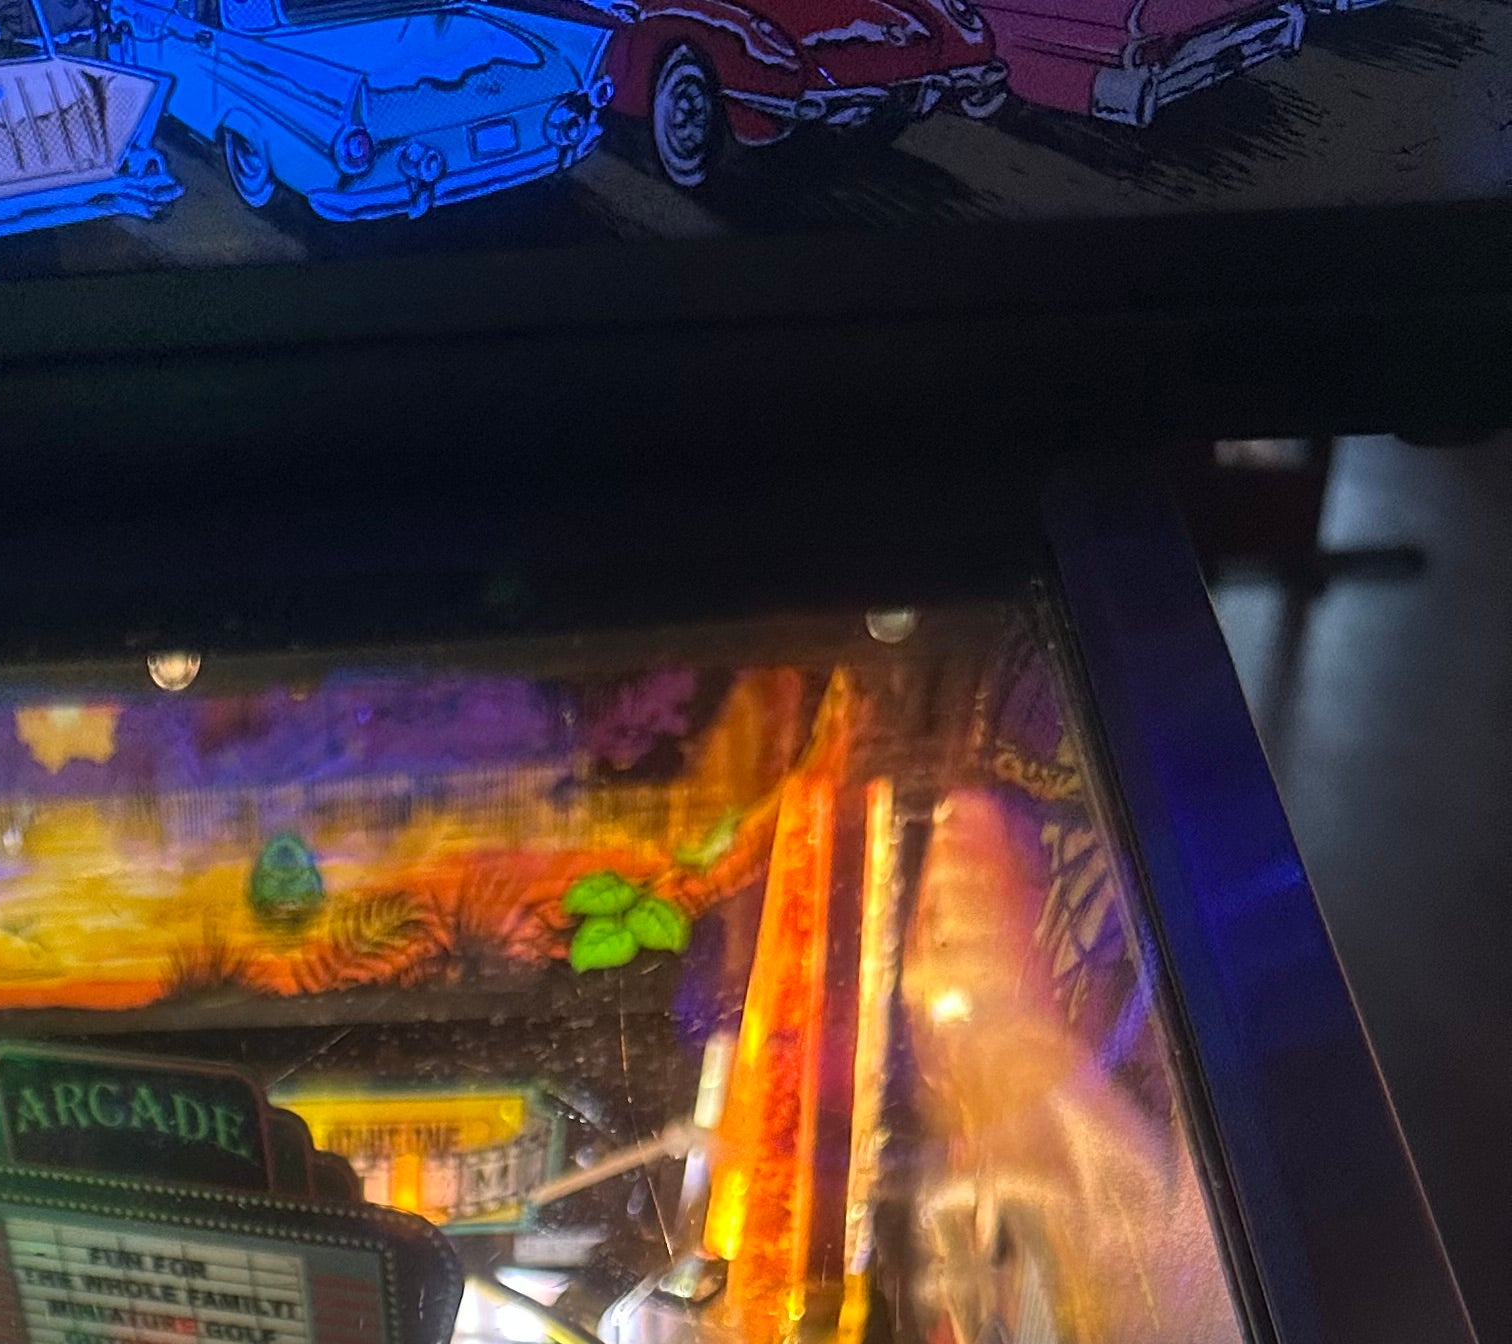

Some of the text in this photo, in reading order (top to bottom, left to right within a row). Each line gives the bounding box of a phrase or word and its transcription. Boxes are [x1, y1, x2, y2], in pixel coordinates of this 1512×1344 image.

[15, 1081, 258, 1160] ARCADE
[89, 1247, 208, 1279] FUN FOR
[80, 1275, 178, 1303] WHOLE
